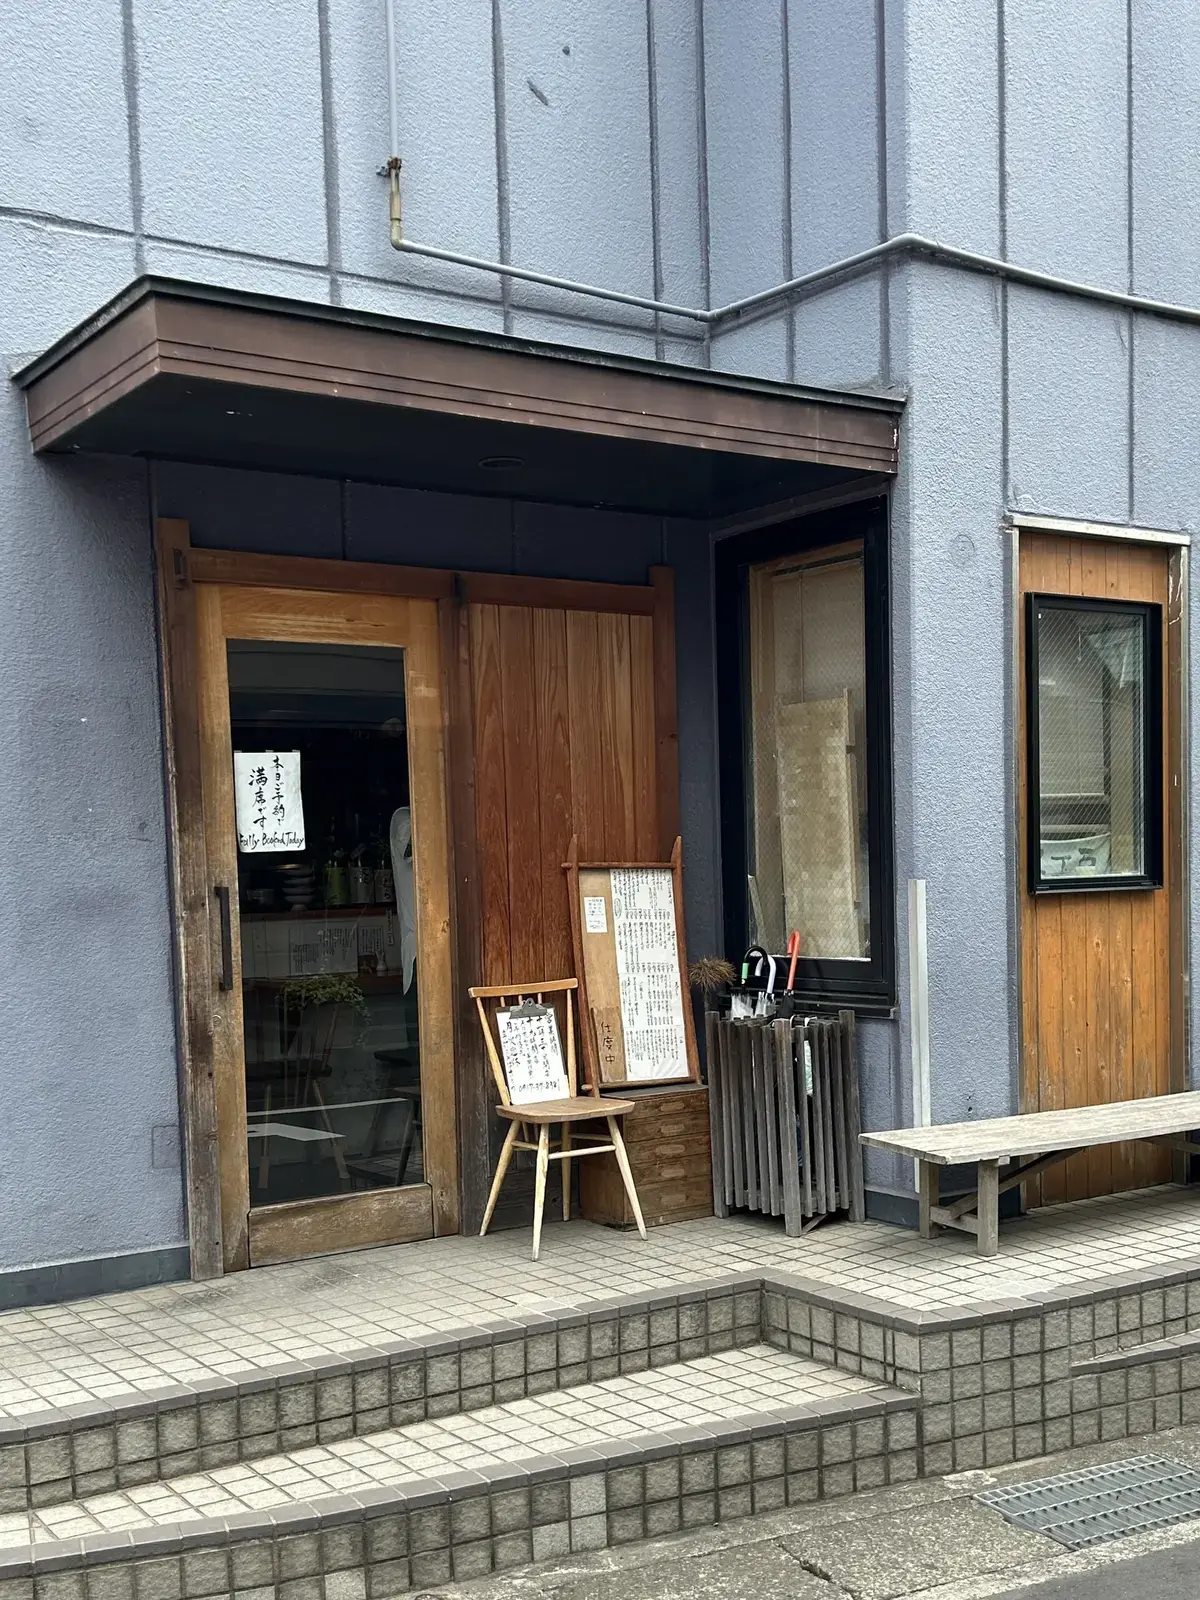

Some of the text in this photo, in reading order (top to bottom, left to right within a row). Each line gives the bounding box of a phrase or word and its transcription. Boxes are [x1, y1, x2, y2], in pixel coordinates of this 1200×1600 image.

[248, 766, 268, 831] 満席です
[270, 755, 285, 826] 本日ご予約で
[285, 831, 305, 848] Today
[600, 1021, 616, 1066] 仕度中
